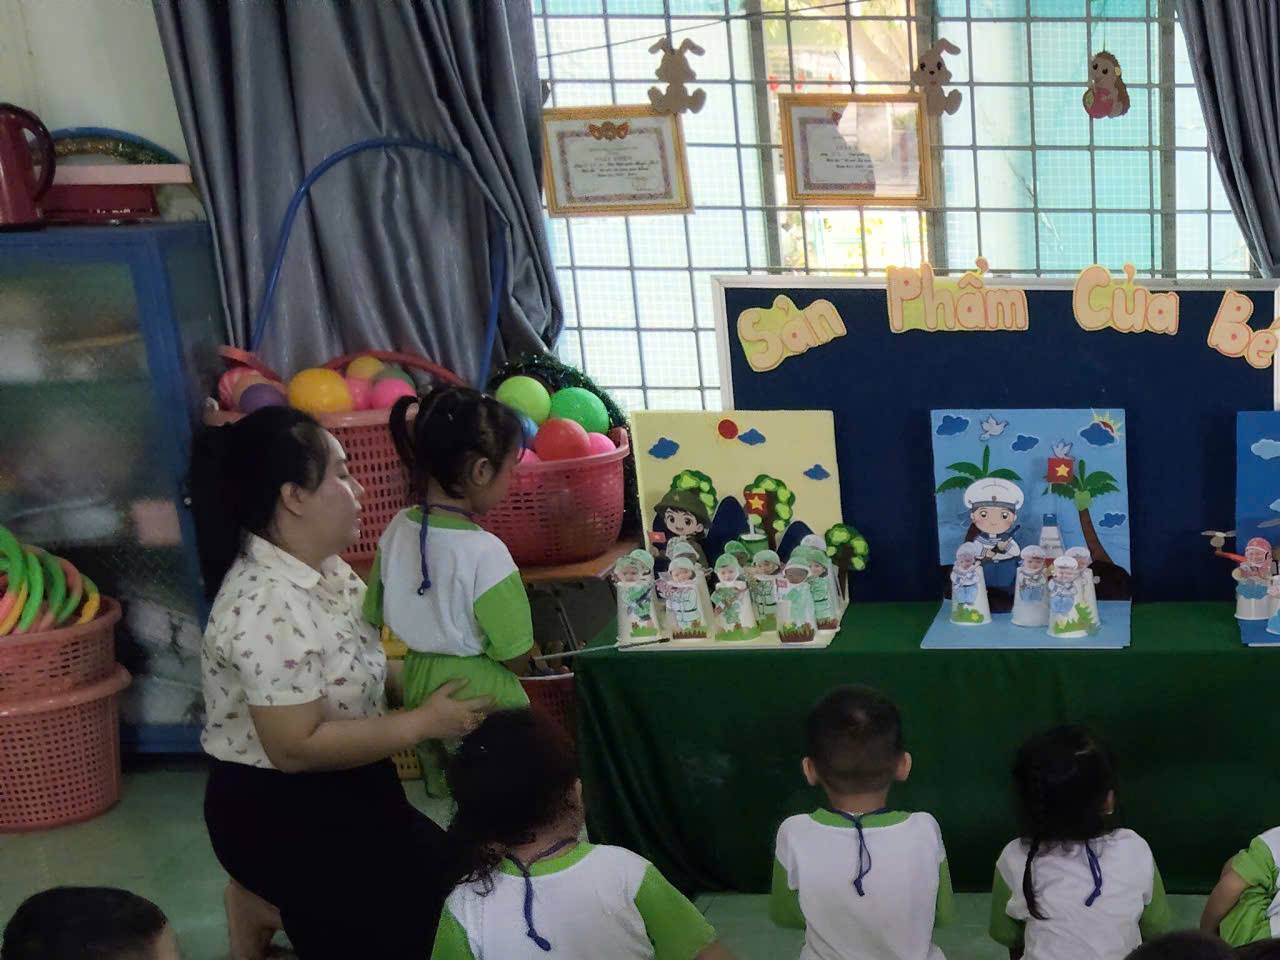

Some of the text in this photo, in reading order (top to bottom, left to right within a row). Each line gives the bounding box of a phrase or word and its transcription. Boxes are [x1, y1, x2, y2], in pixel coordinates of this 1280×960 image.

[738, 295, 847, 372] Sản
[886, 256, 1029, 333] Phẩm
[1073, 263, 1179, 335] Của
